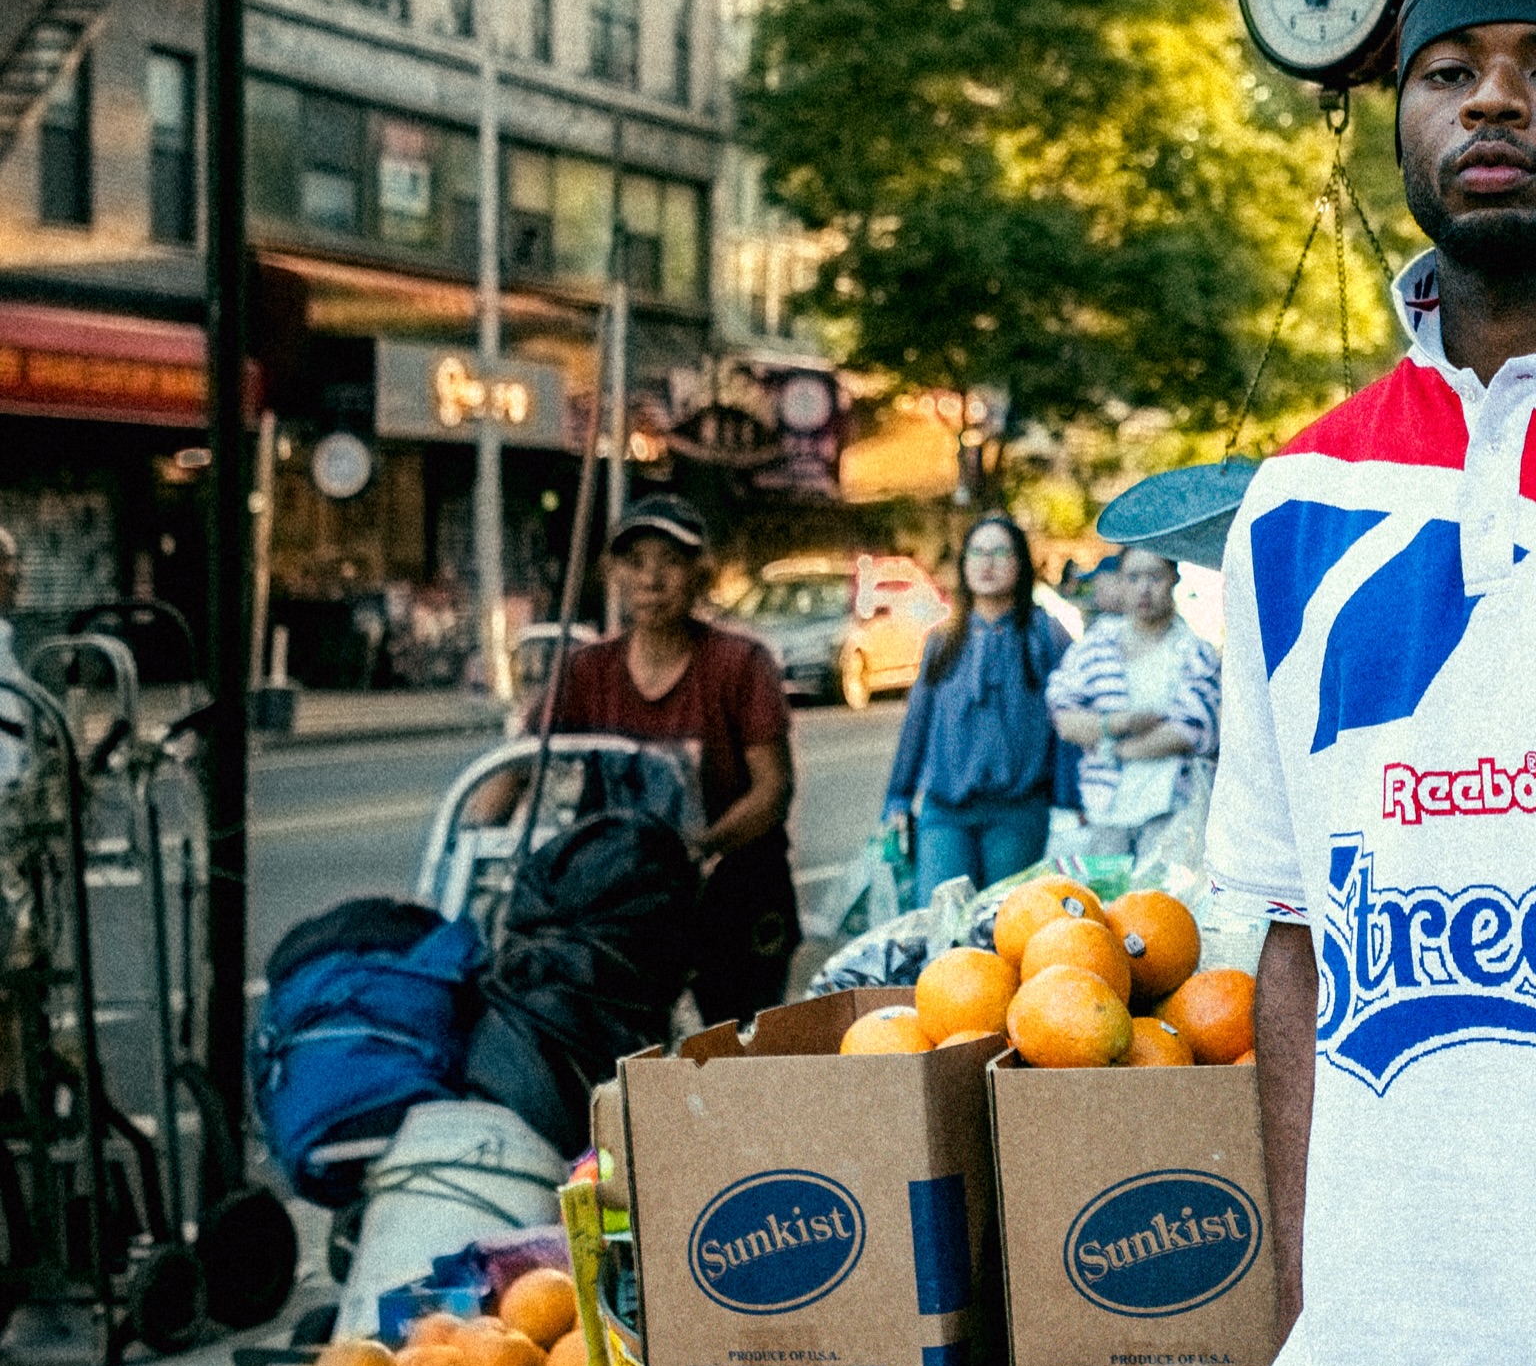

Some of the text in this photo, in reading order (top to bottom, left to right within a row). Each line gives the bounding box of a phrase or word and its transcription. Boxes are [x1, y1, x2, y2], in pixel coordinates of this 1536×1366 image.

[702, 1205, 852, 1284] Sunkist
[1078, 1206, 1248, 1285] Sunkist
[729, 1350, 842, 1362] PRODUCE OF U.S.A.
[1111, 1354, 1235, 1365] PRODUCE OF U.S.A.
